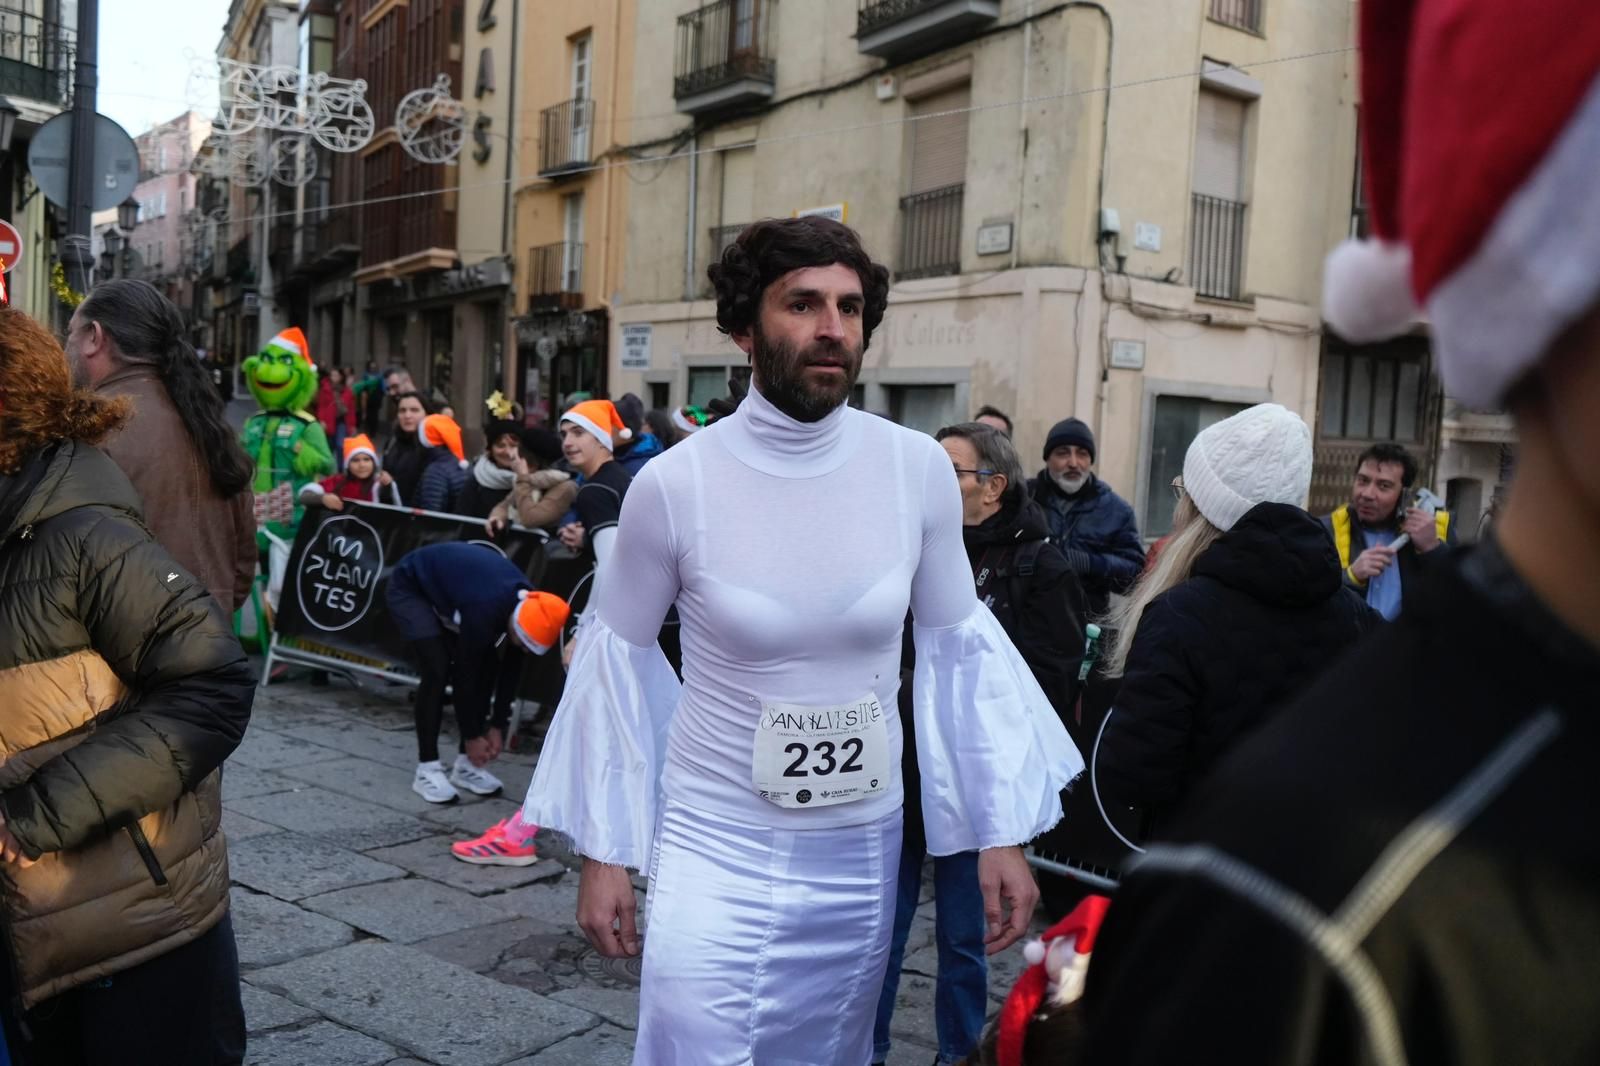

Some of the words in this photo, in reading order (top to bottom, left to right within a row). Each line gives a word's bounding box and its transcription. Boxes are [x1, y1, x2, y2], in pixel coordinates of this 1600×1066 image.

[976, 567, 990, 586] EOS
[313, 582, 356, 612] TES
[783, 737, 863, 777] 232
